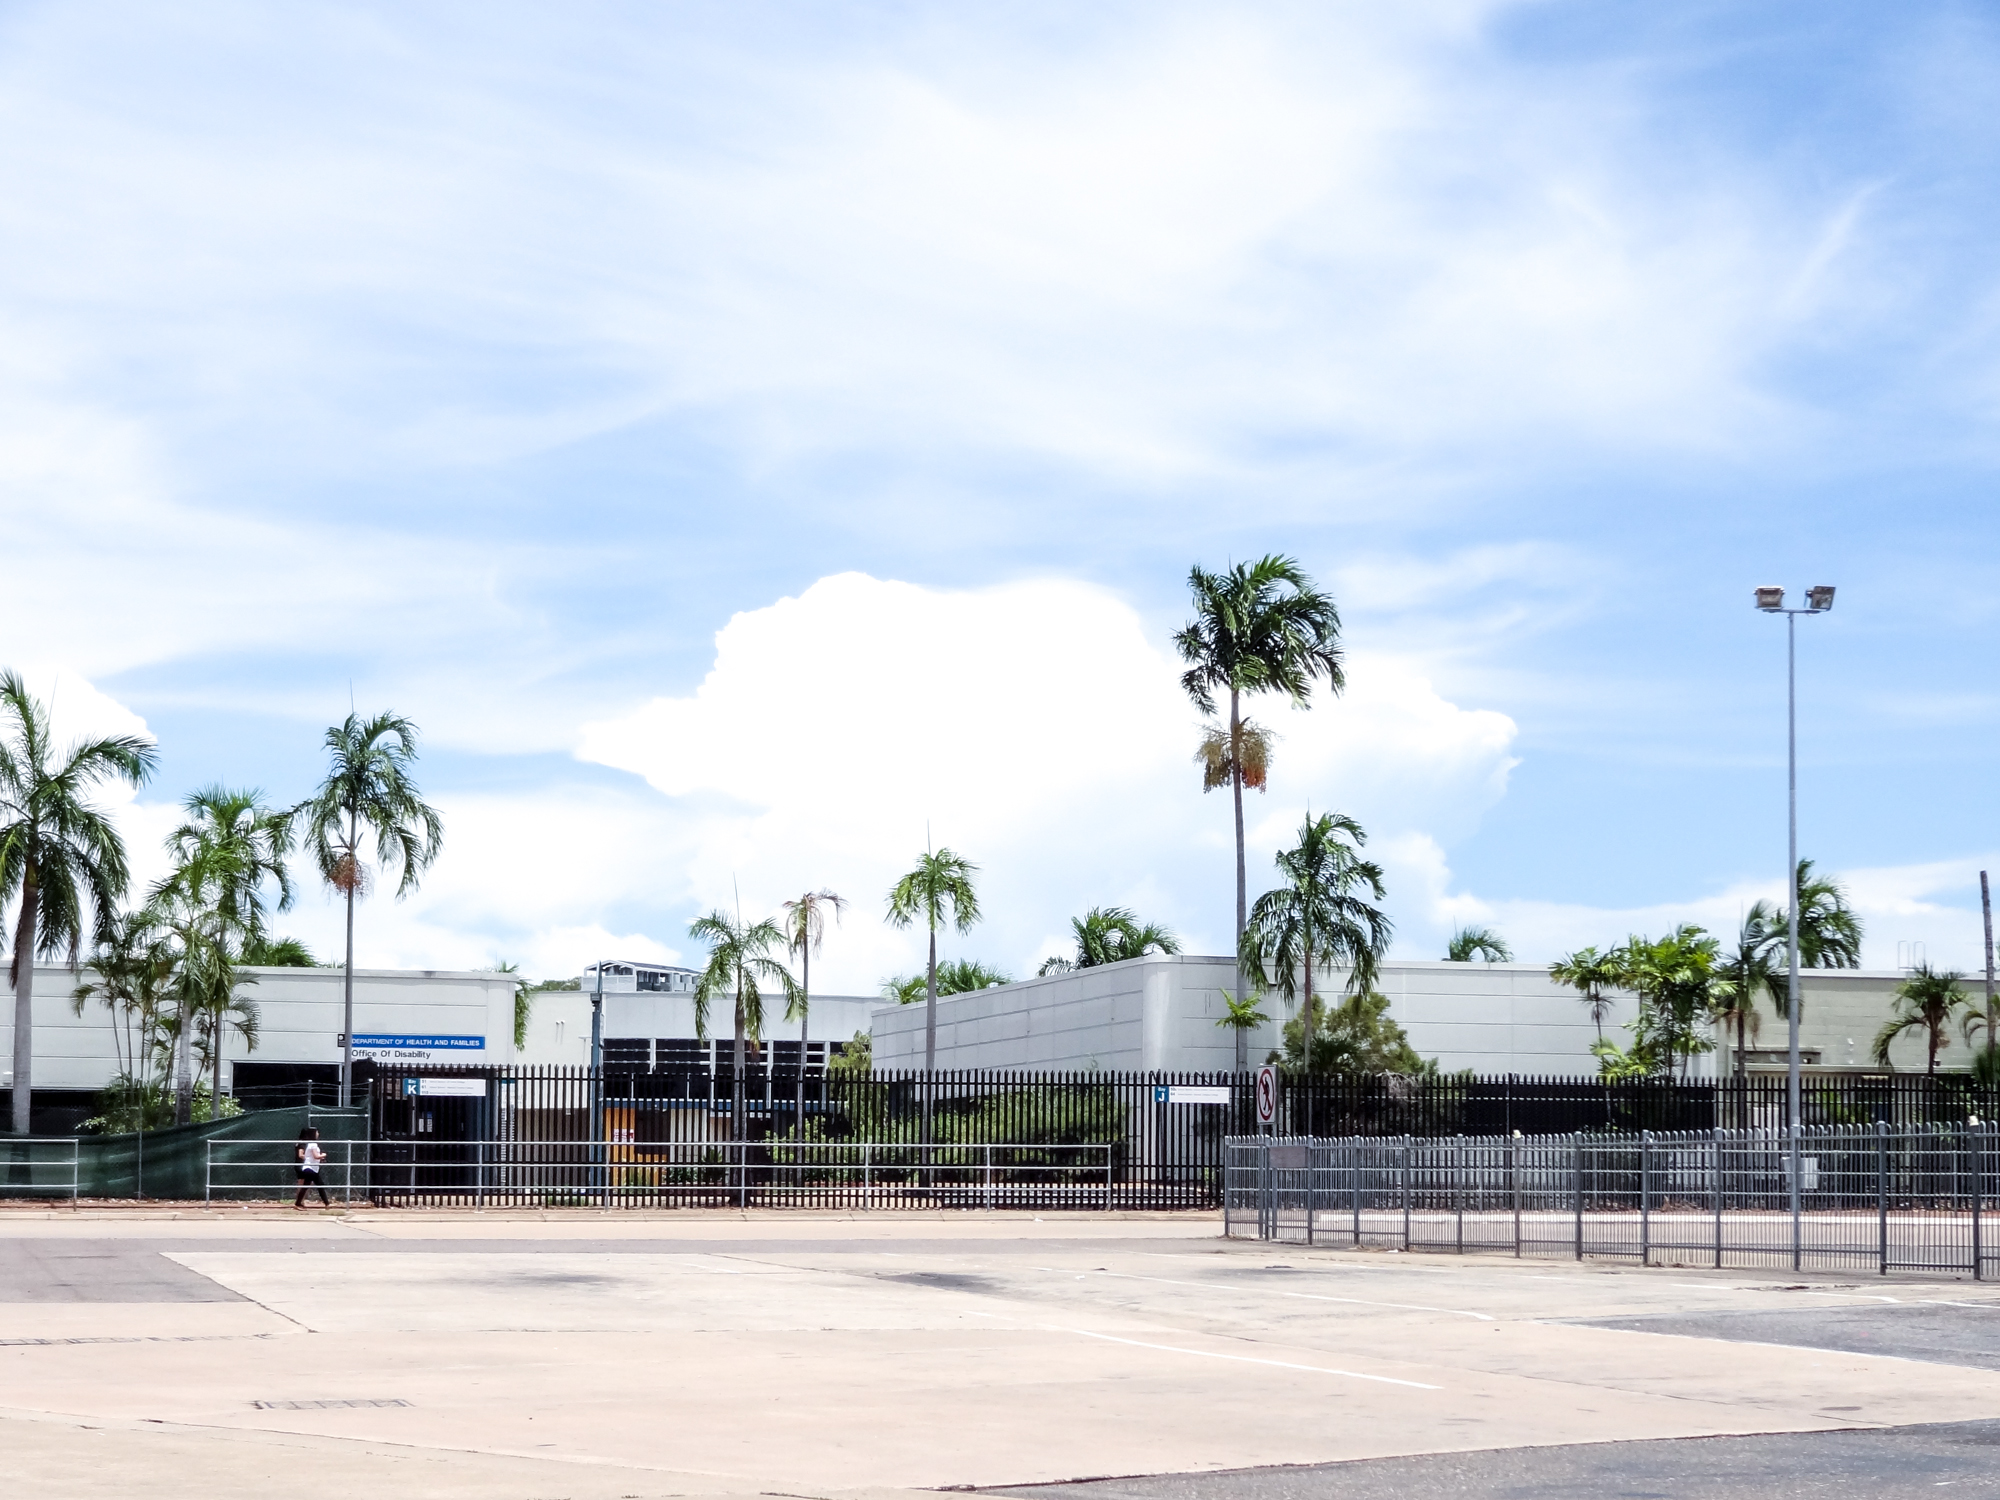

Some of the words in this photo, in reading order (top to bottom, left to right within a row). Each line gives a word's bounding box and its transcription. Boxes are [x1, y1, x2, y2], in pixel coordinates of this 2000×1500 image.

[351, 1049, 377, 1058] Office
[380, 1050, 391, 1058] Of
[394, 1050, 431, 1059] Disability
[407, 1084, 417, 1095] K
[1158, 1092, 1166, 1102] J
